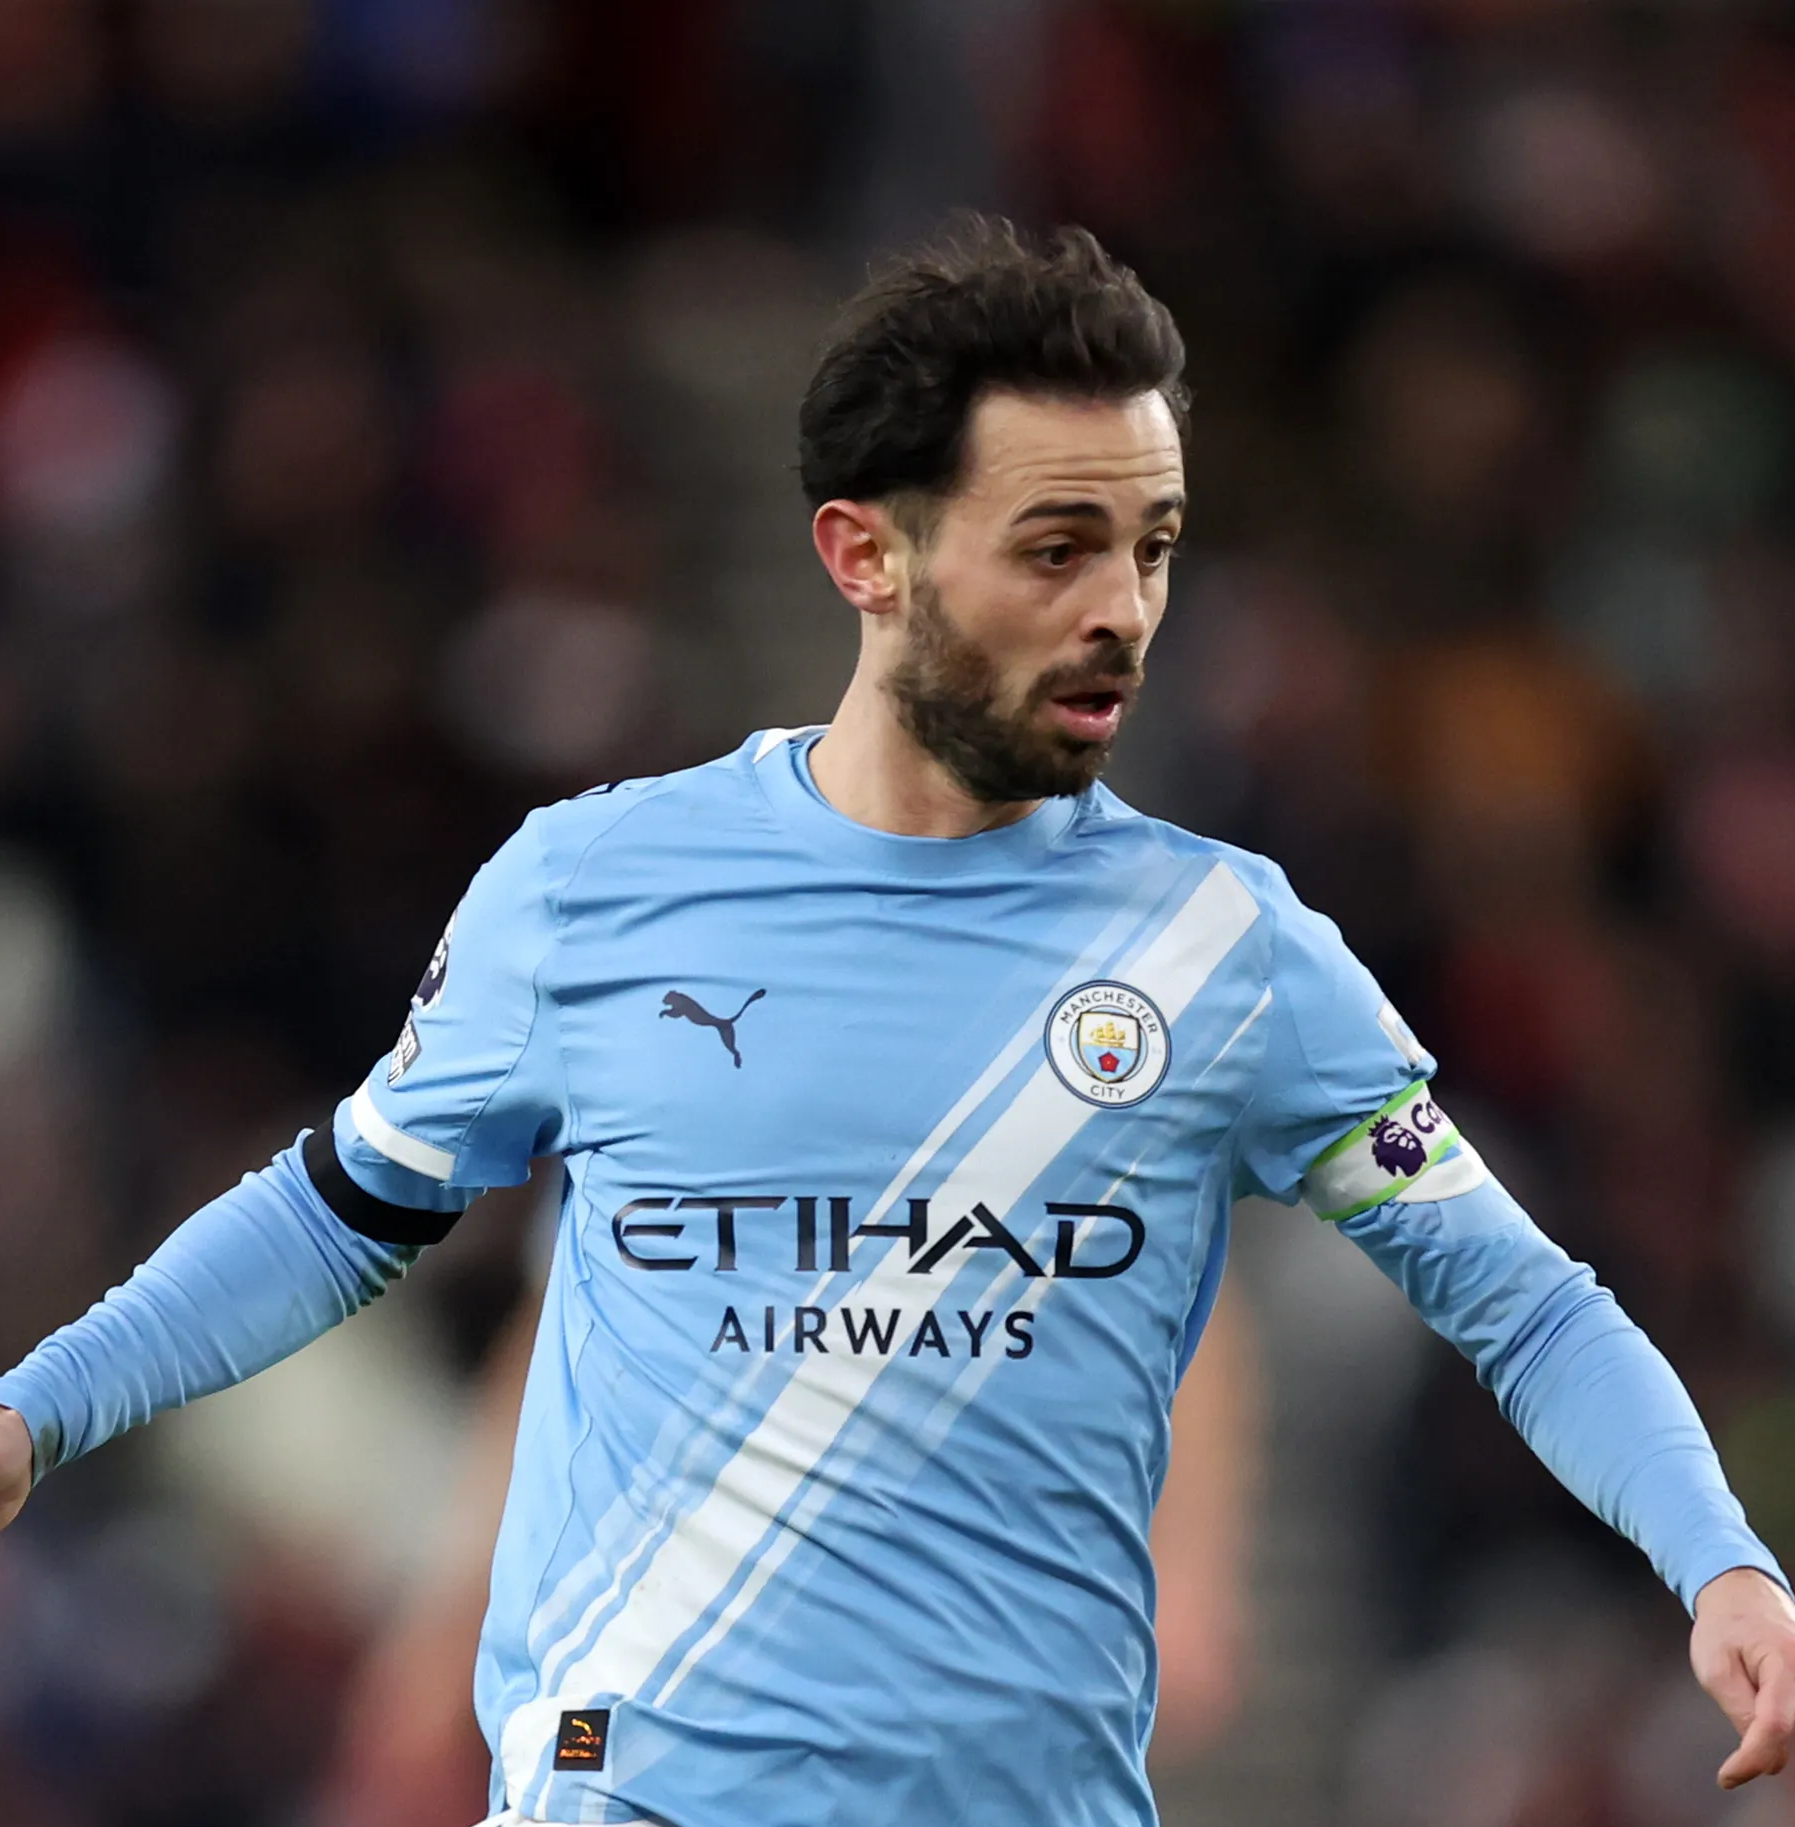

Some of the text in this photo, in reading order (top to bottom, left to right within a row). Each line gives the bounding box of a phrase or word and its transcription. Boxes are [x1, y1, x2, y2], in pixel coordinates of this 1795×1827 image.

[1061, 991, 1158, 1034] MANCHESTER
[1090, 1086, 1125, 1099] CITY
[612, 1197, 1146, 1279] ETIHAD
[710, 1305, 1035, 1360] AIRWAYS
